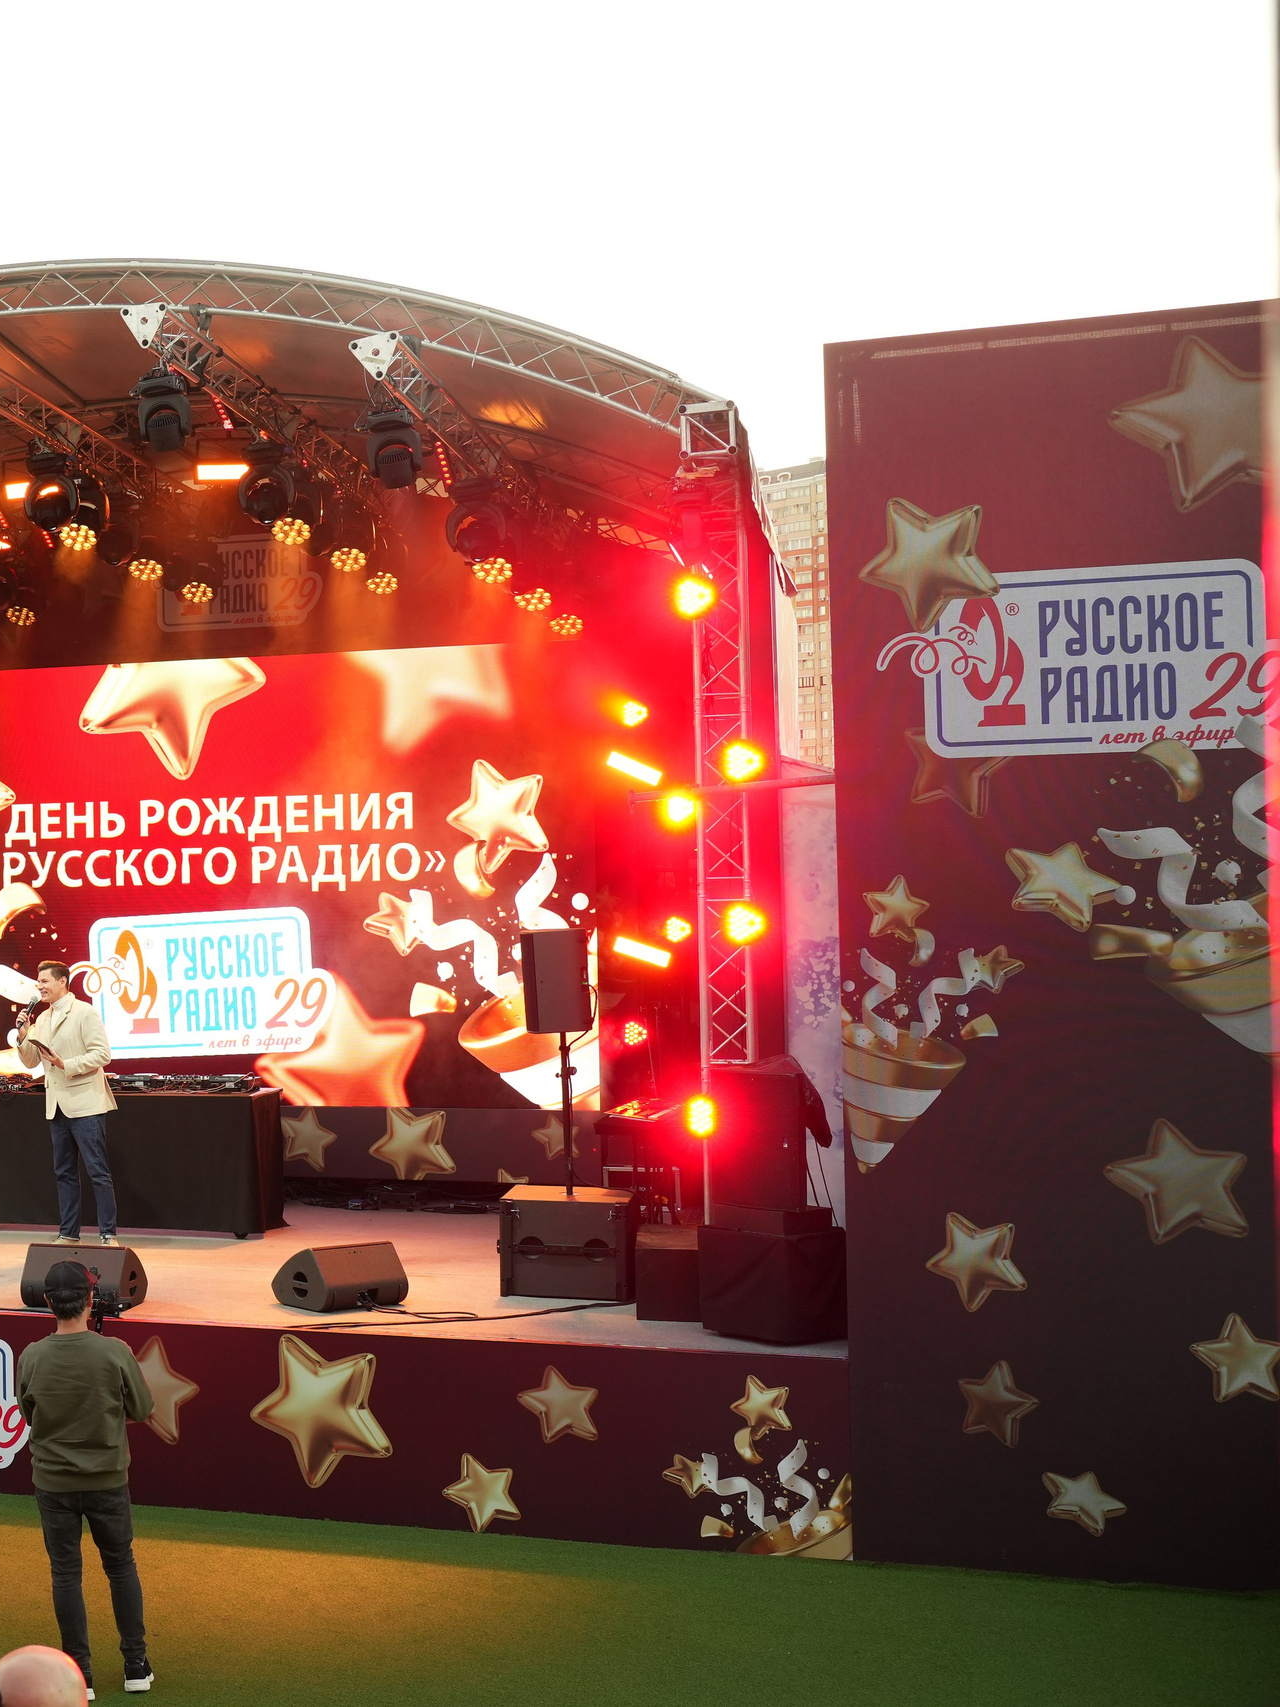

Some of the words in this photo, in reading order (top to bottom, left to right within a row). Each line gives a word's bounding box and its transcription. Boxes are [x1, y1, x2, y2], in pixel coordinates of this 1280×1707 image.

[220, 548, 289, 580] УССКОЕ
[273, 576, 318, 612] 29
[1037, 590, 1225, 658] РУССКОЕ
[1040, 661, 1178, 724] РАДИО
[1189, 650, 1280, 720] 29
[1099, 731, 1147, 745] лет
[1152, 725, 1168, 742] в
[1172, 724, 1235, 748] эфир
[4, 801, 126, 848] ДЕНЬ
[140, 791, 413, 842] РОЖДЕНИЯ
[251, 842, 447, 892] РАДИО»
[166, 932, 285, 982] РУССКОЕ
[168, 985, 257, 1034] РАДИО
[265, 977, 328, 1030] 29
[207, 1036, 238, 1050] лет
[241, 1033, 252, 1048] в
[255, 1034, 302, 1052] эфире
